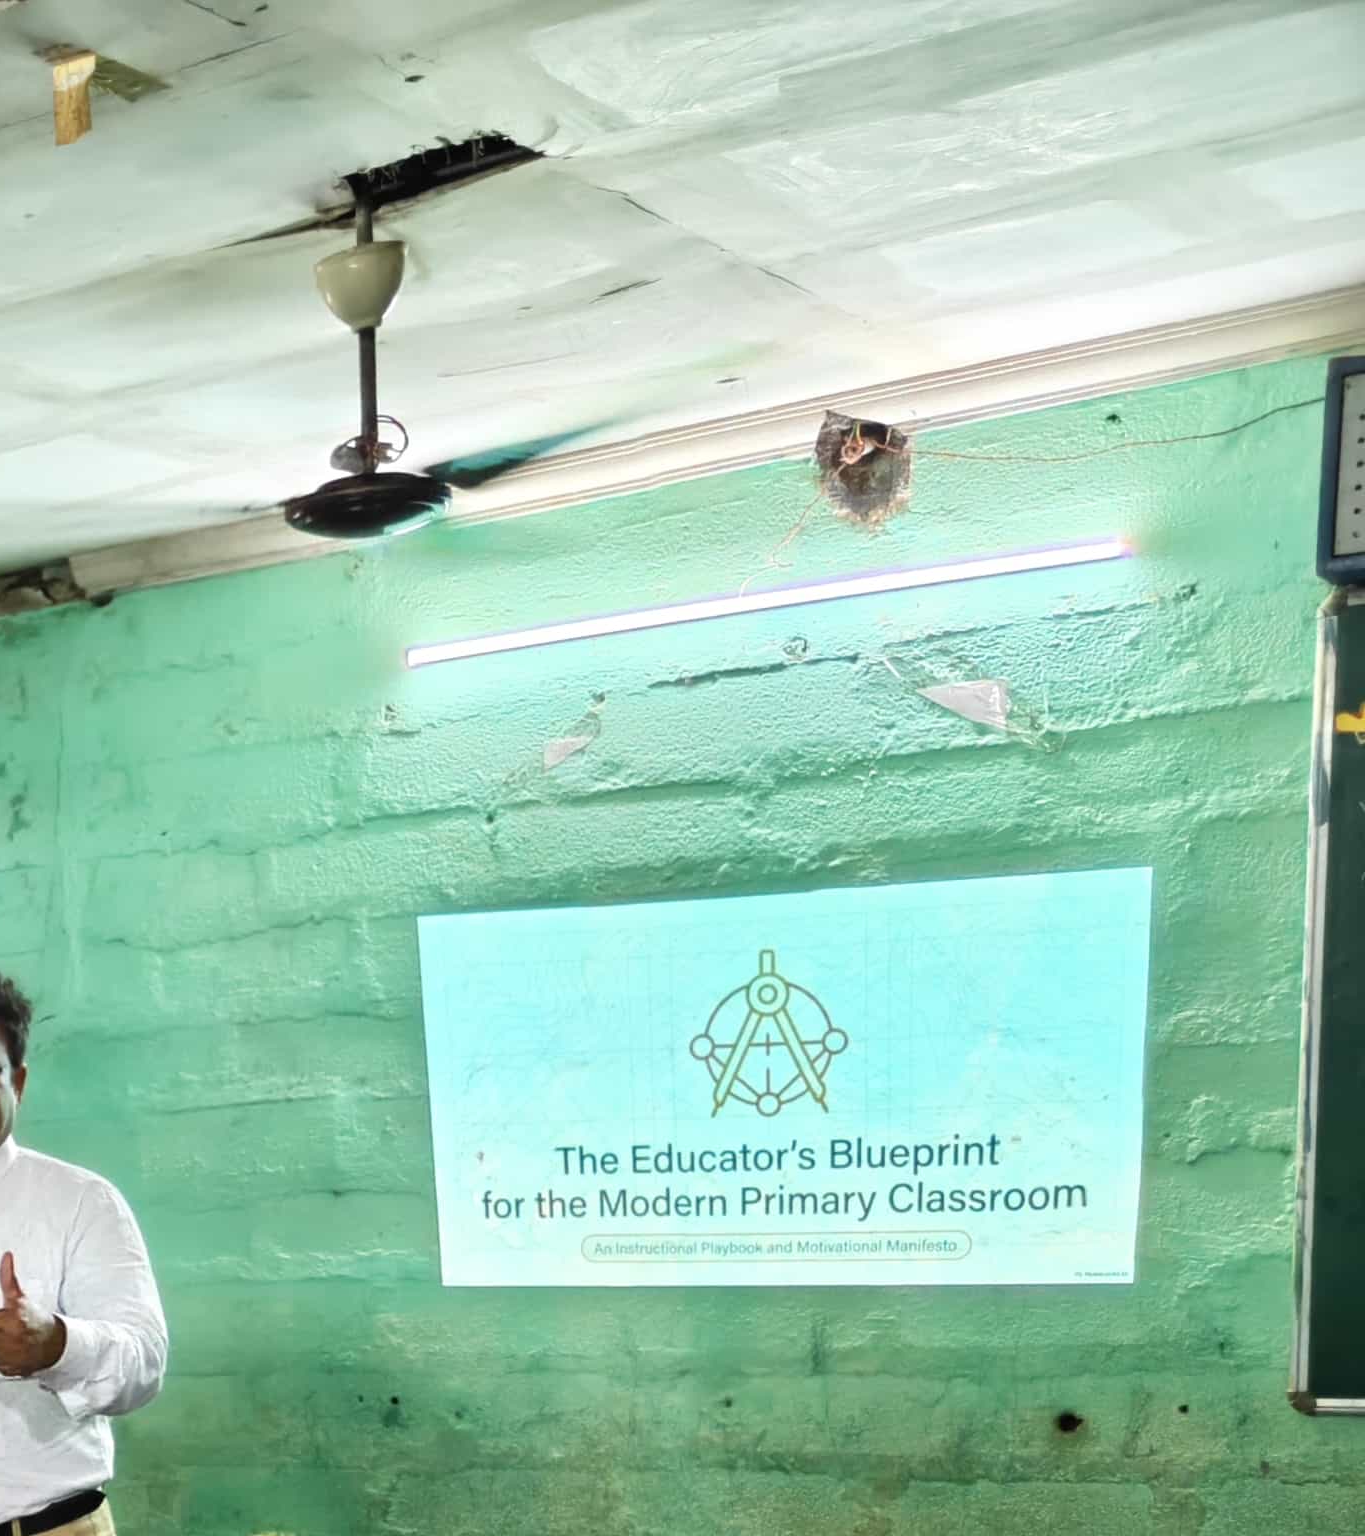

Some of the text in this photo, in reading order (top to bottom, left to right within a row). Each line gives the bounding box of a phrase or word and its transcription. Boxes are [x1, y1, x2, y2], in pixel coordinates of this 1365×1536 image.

[555, 1134, 1001, 1176] The Educator's Blueprint
[482, 1181, 1088, 1222] for the Modern Primary Classroom
[594, 1238, 958, 1257] An Instructional Playbook and Motivational Manifesto
